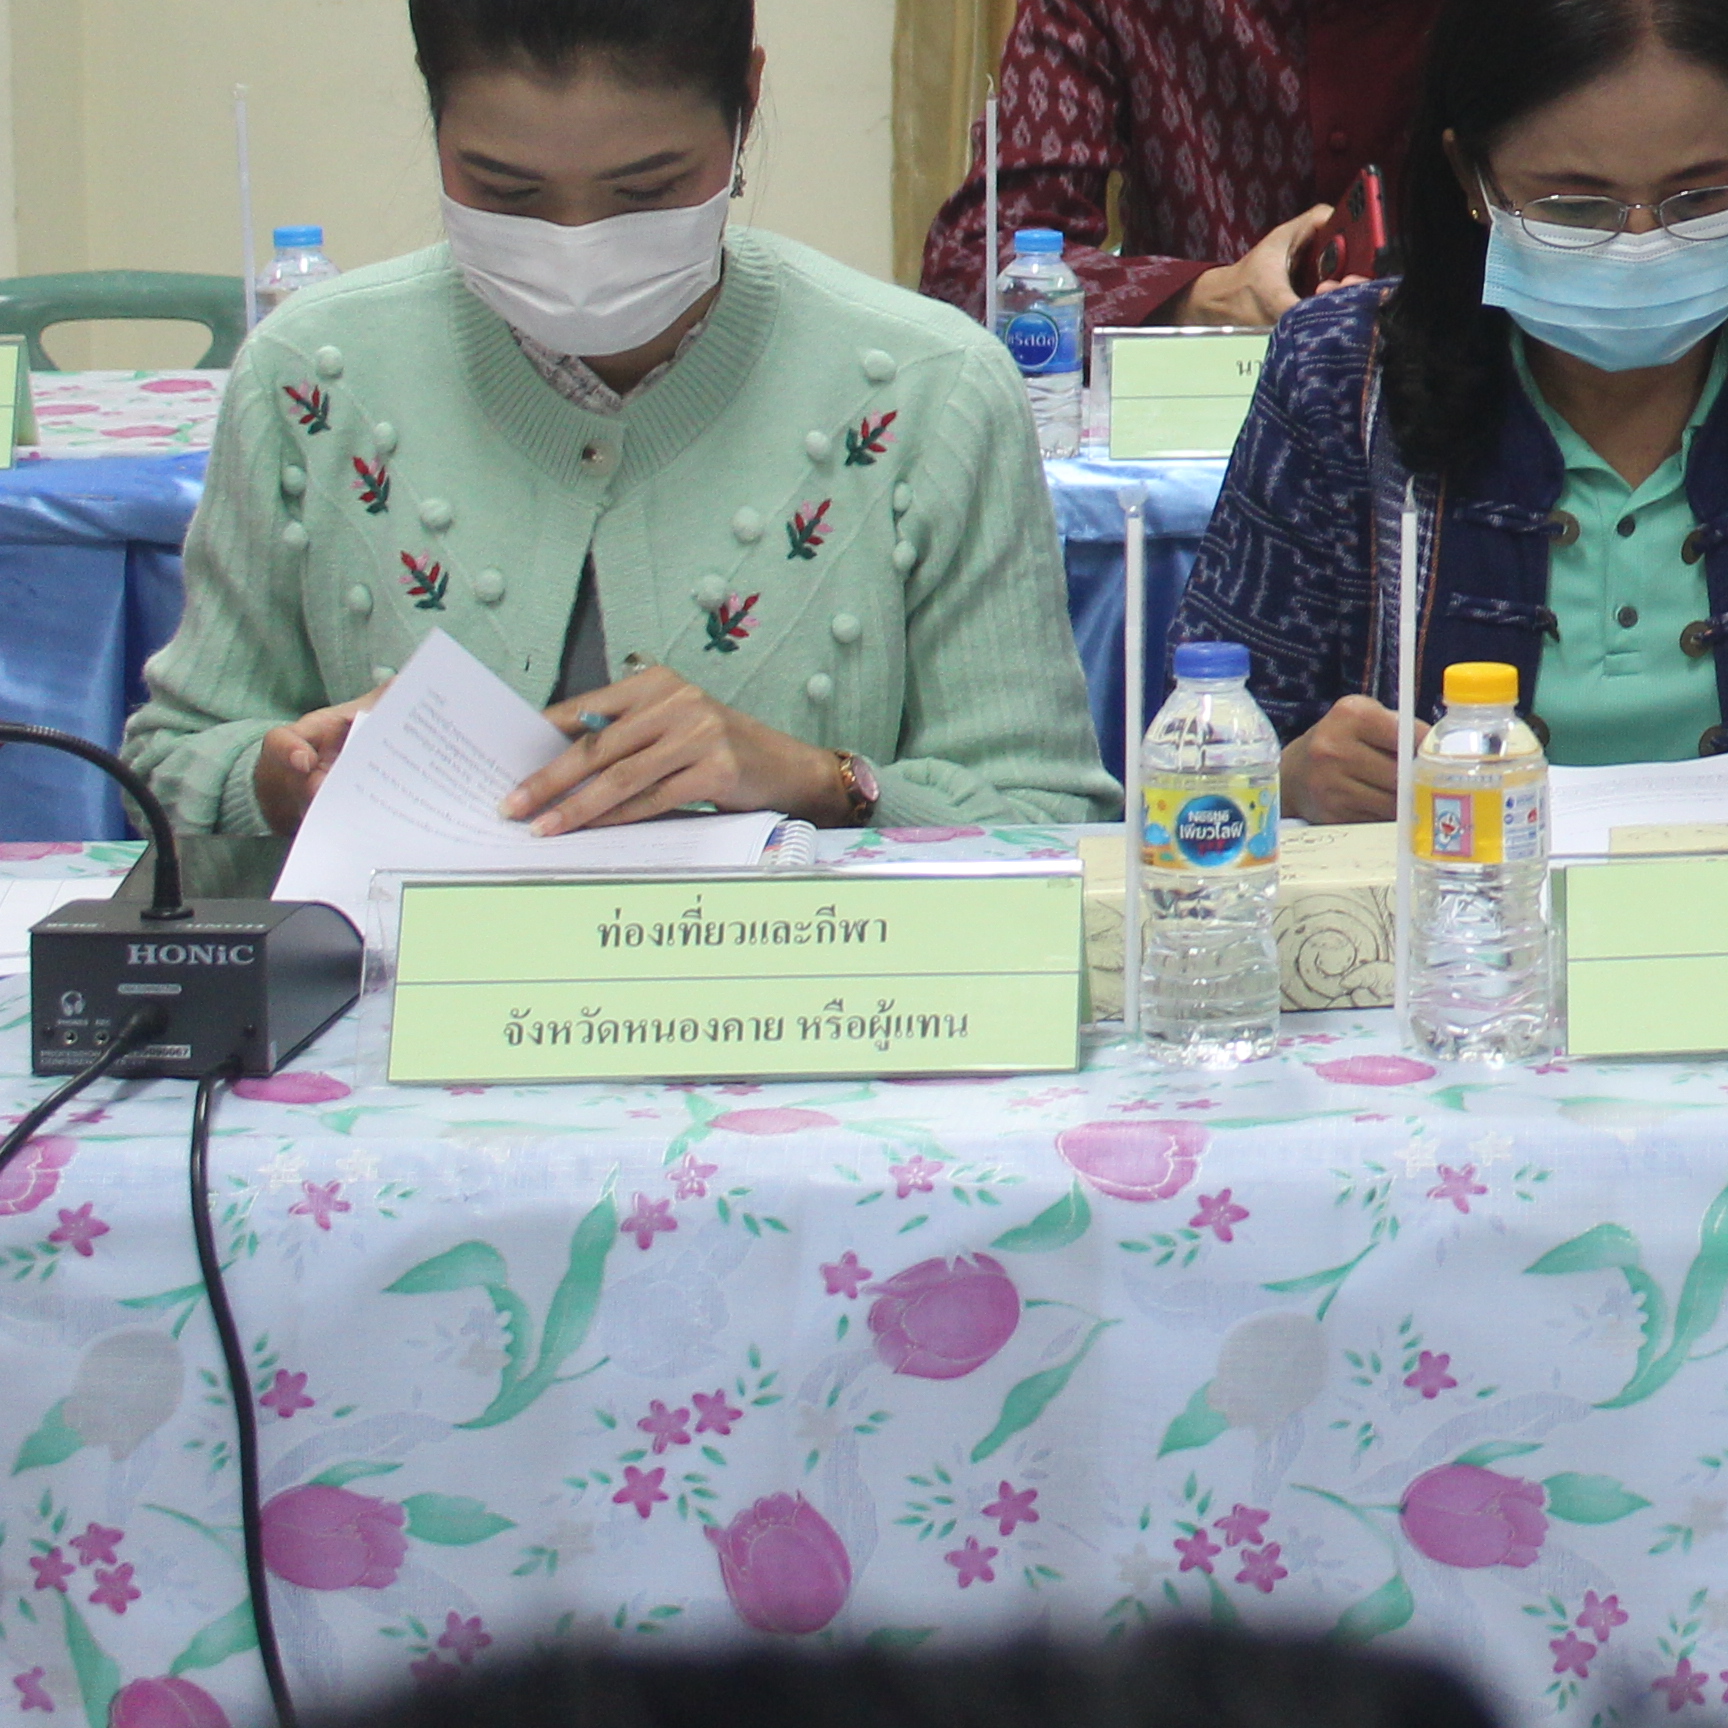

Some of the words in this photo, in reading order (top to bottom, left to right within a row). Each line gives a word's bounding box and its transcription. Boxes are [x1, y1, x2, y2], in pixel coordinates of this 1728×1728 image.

[596, 894, 889, 949] ท่องเที่ยวและกีฬา
[503, 1007, 785, 1047] จังหวัดหนองคาย
[796, 997, 969, 1052] หรือผู้แทน
